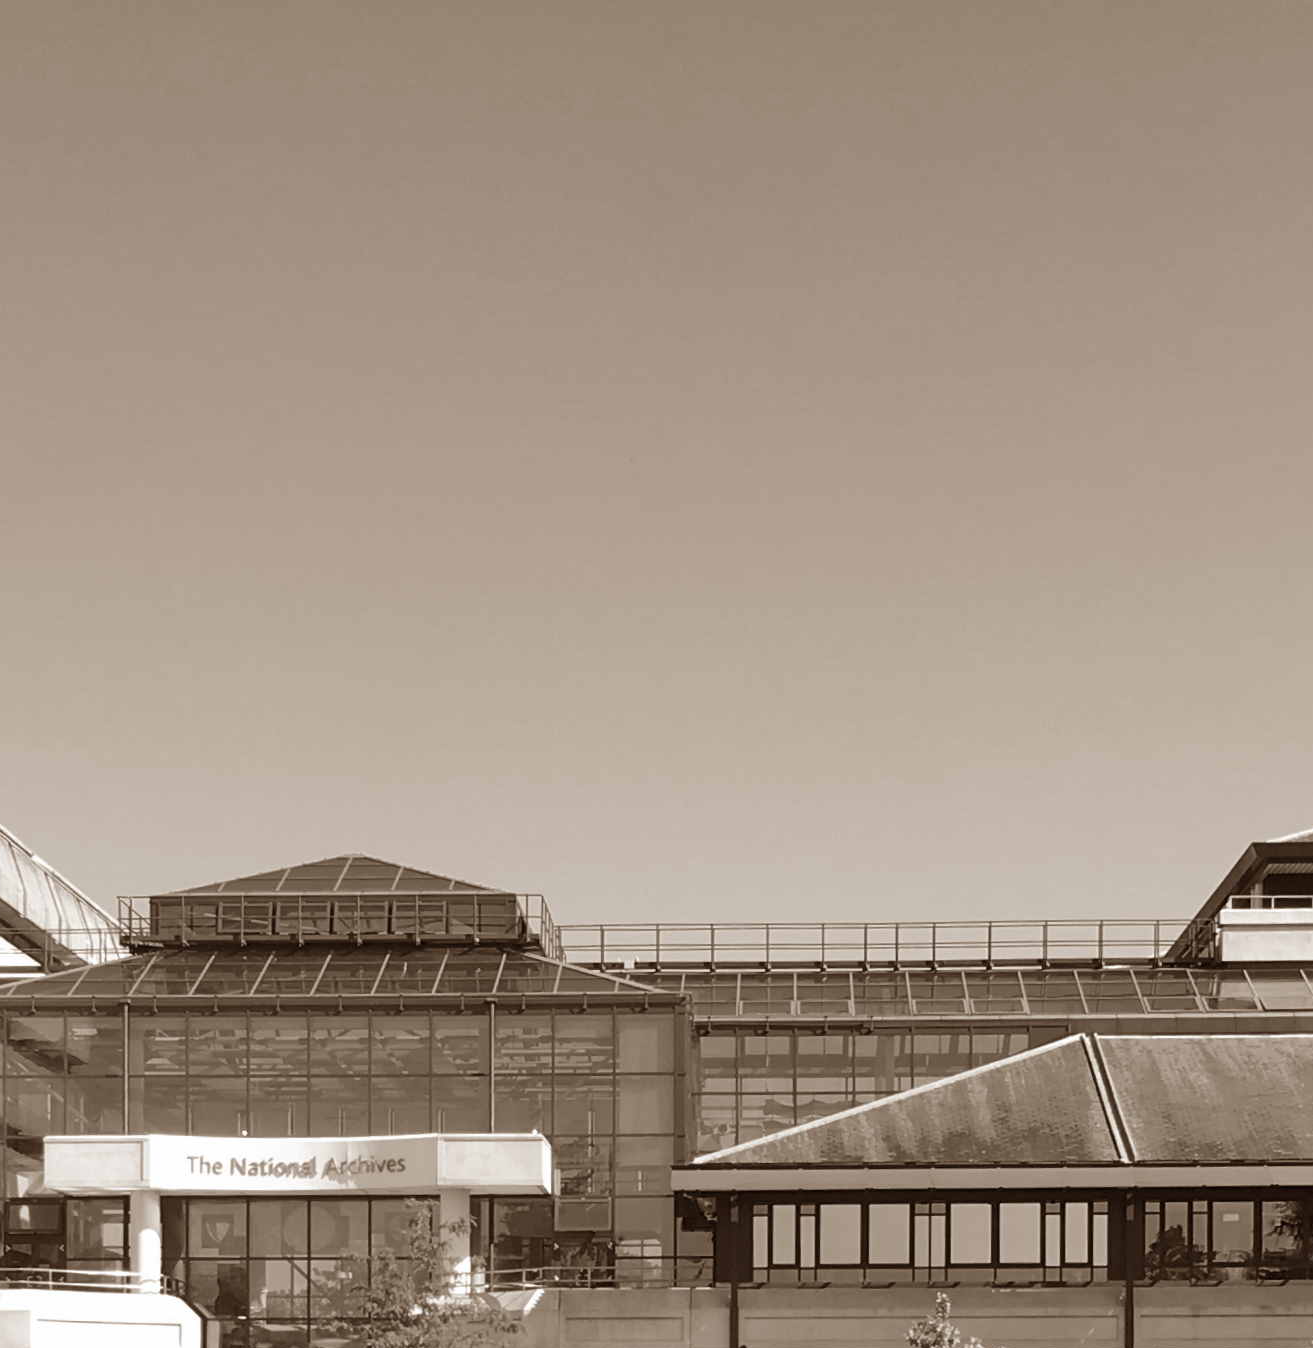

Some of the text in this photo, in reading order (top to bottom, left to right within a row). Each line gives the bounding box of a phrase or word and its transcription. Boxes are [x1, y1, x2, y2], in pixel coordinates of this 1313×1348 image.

[187, 1155, 406, 1178] The National Archives
